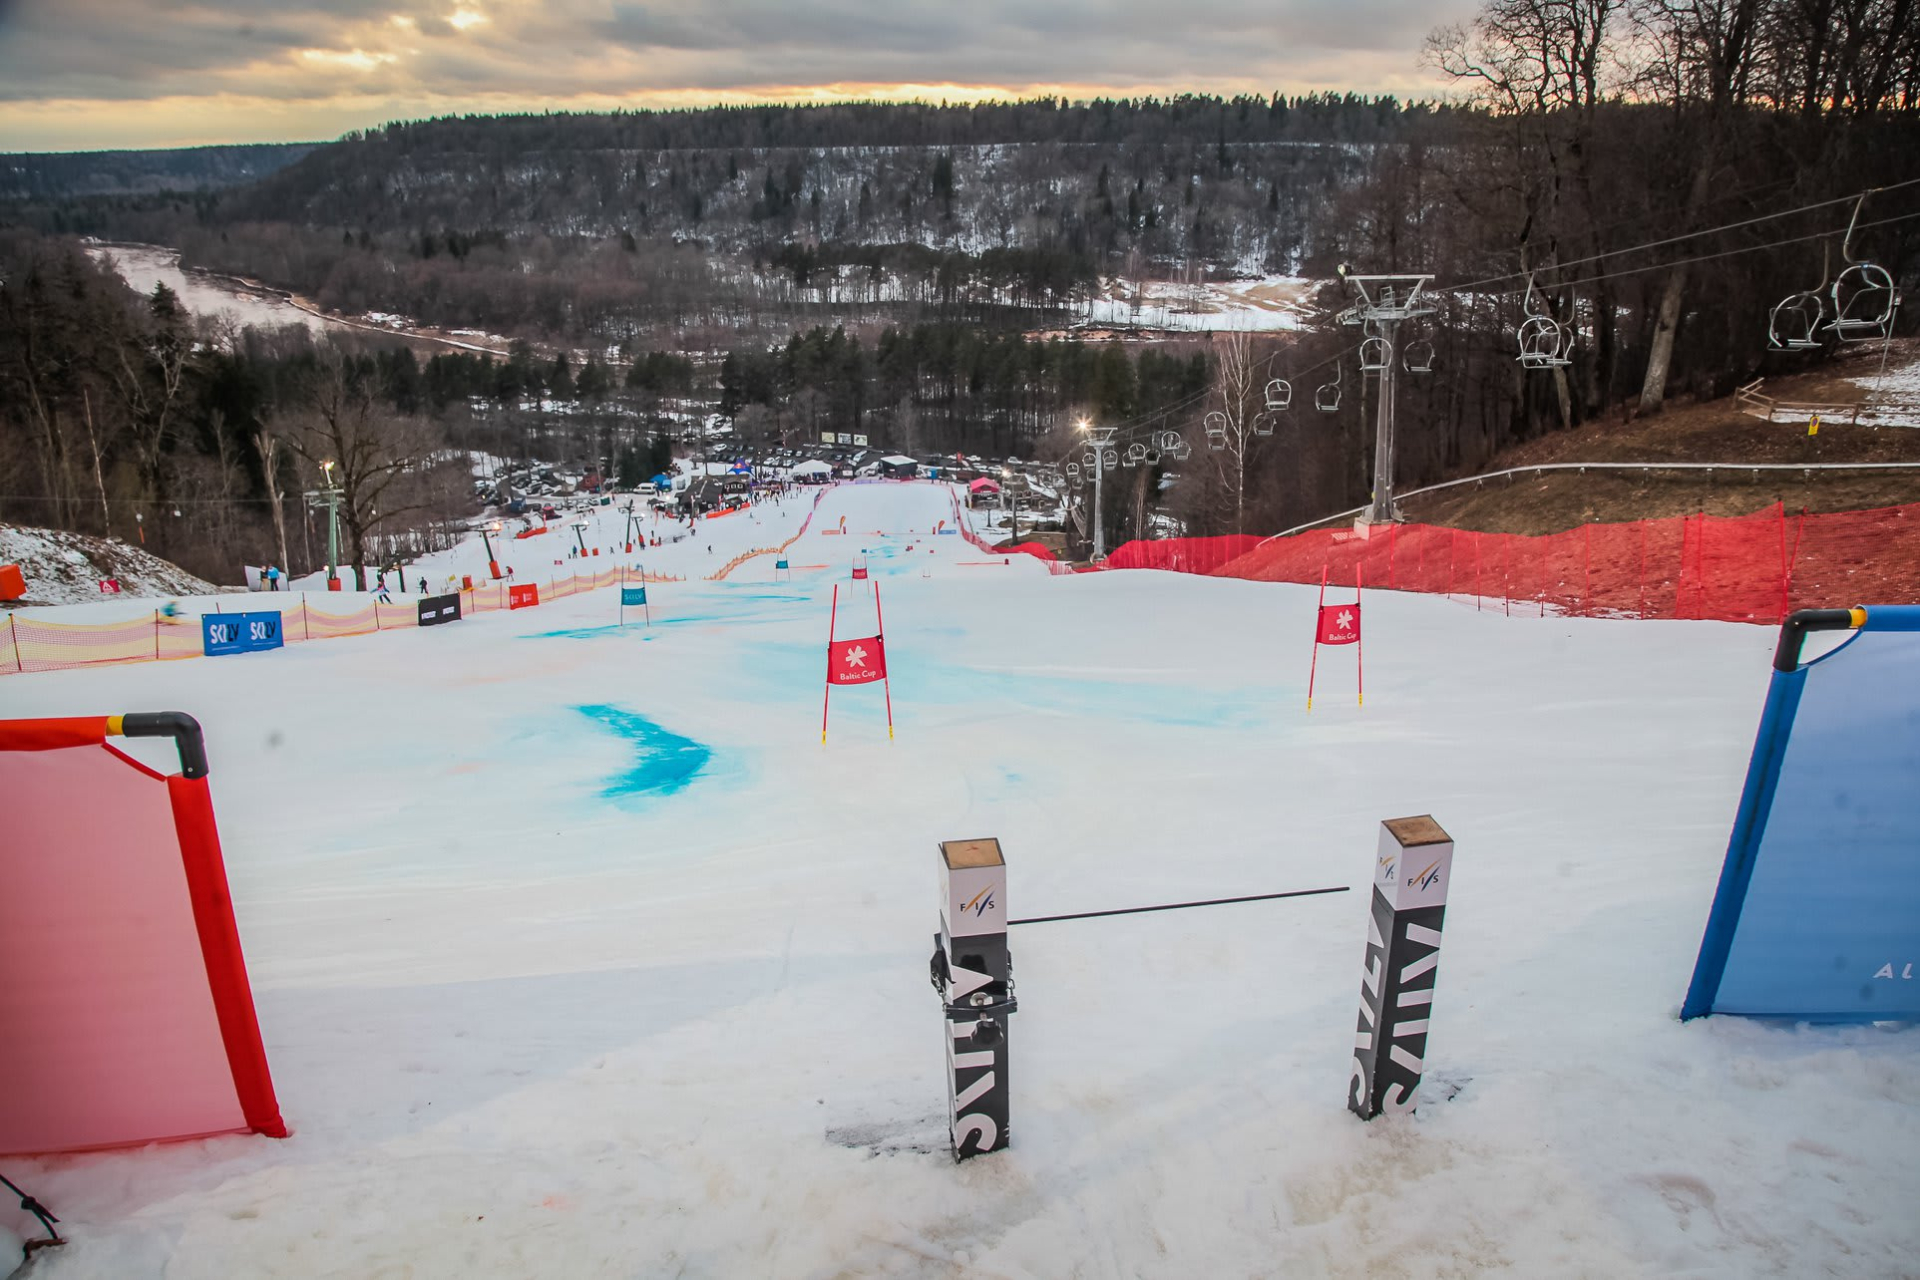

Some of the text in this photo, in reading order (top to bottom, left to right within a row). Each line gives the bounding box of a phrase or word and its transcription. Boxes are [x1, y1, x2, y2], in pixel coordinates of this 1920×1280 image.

[1329, 632, 1357, 641] Baltic Cup
[840, 670, 876, 680] Baltic Cup
[959, 900, 995, 912] FIS
